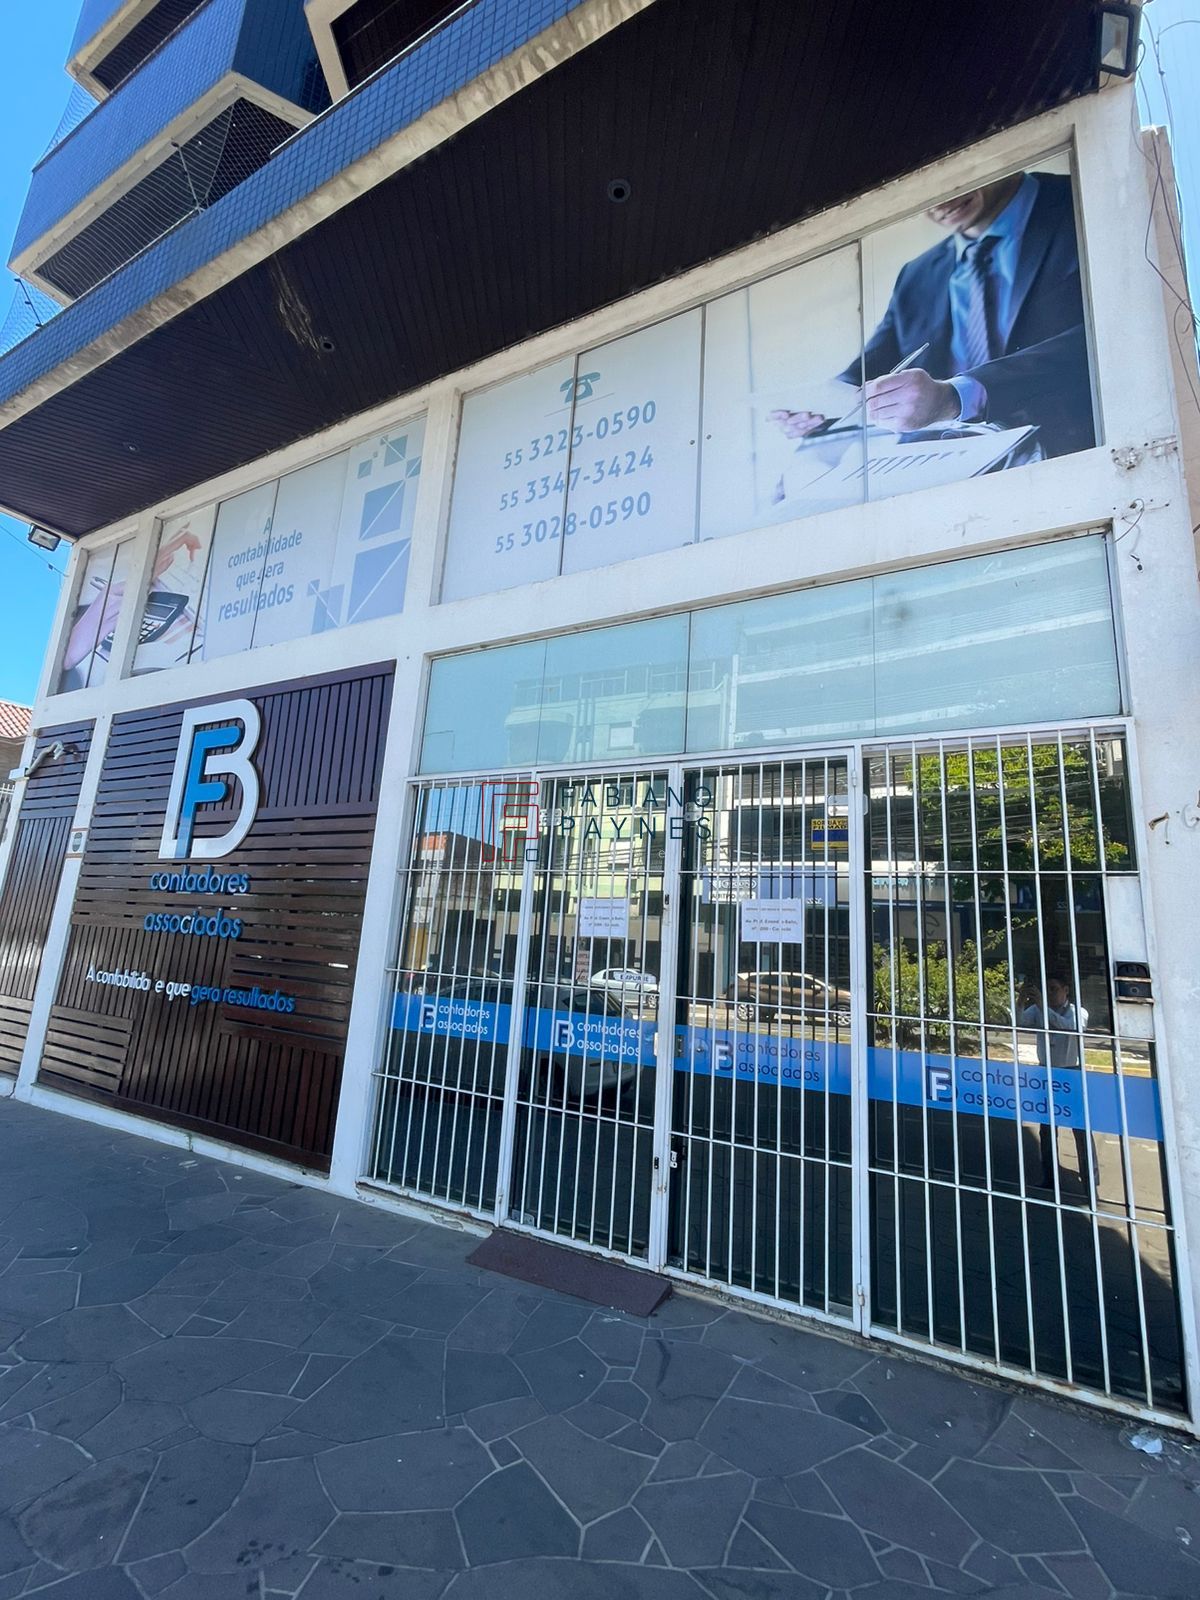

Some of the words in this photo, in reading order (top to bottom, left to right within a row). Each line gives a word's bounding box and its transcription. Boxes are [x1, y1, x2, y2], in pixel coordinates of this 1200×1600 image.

[503, 449, 523, 469] 55
[528, 400, 656, 461] 3223-0590
[499, 490, 519, 511] 55
[524, 445, 653, 503] 3347-3424
[263, 516, 272, 534] A
[494, 532, 515, 553] 55
[521, 491, 651, 547] 3028-0590
[227, 529, 303, 568] contabilidade
[236, 570, 256, 592] que
[218, 583, 294, 622] resultados
[150, 864, 252, 893] contadores
[144, 907, 245, 939] associados
[85, 964, 97, 982] A
[166, 980, 191, 1001] que
[190, 984, 220, 1006] gera
[221, 986, 297, 1014] resultados
[438, 1003, 490, 1019] contadores
[437, 1020, 488, 1035] asocados
[577, 1020, 641, 1039] contadores
[576, 1039, 641, 1057] associados
[738, 1062, 820, 1082] asocados
[961, 1069, 1072, 1094] contadores
[963, 1092, 1072, 1118] assocados
